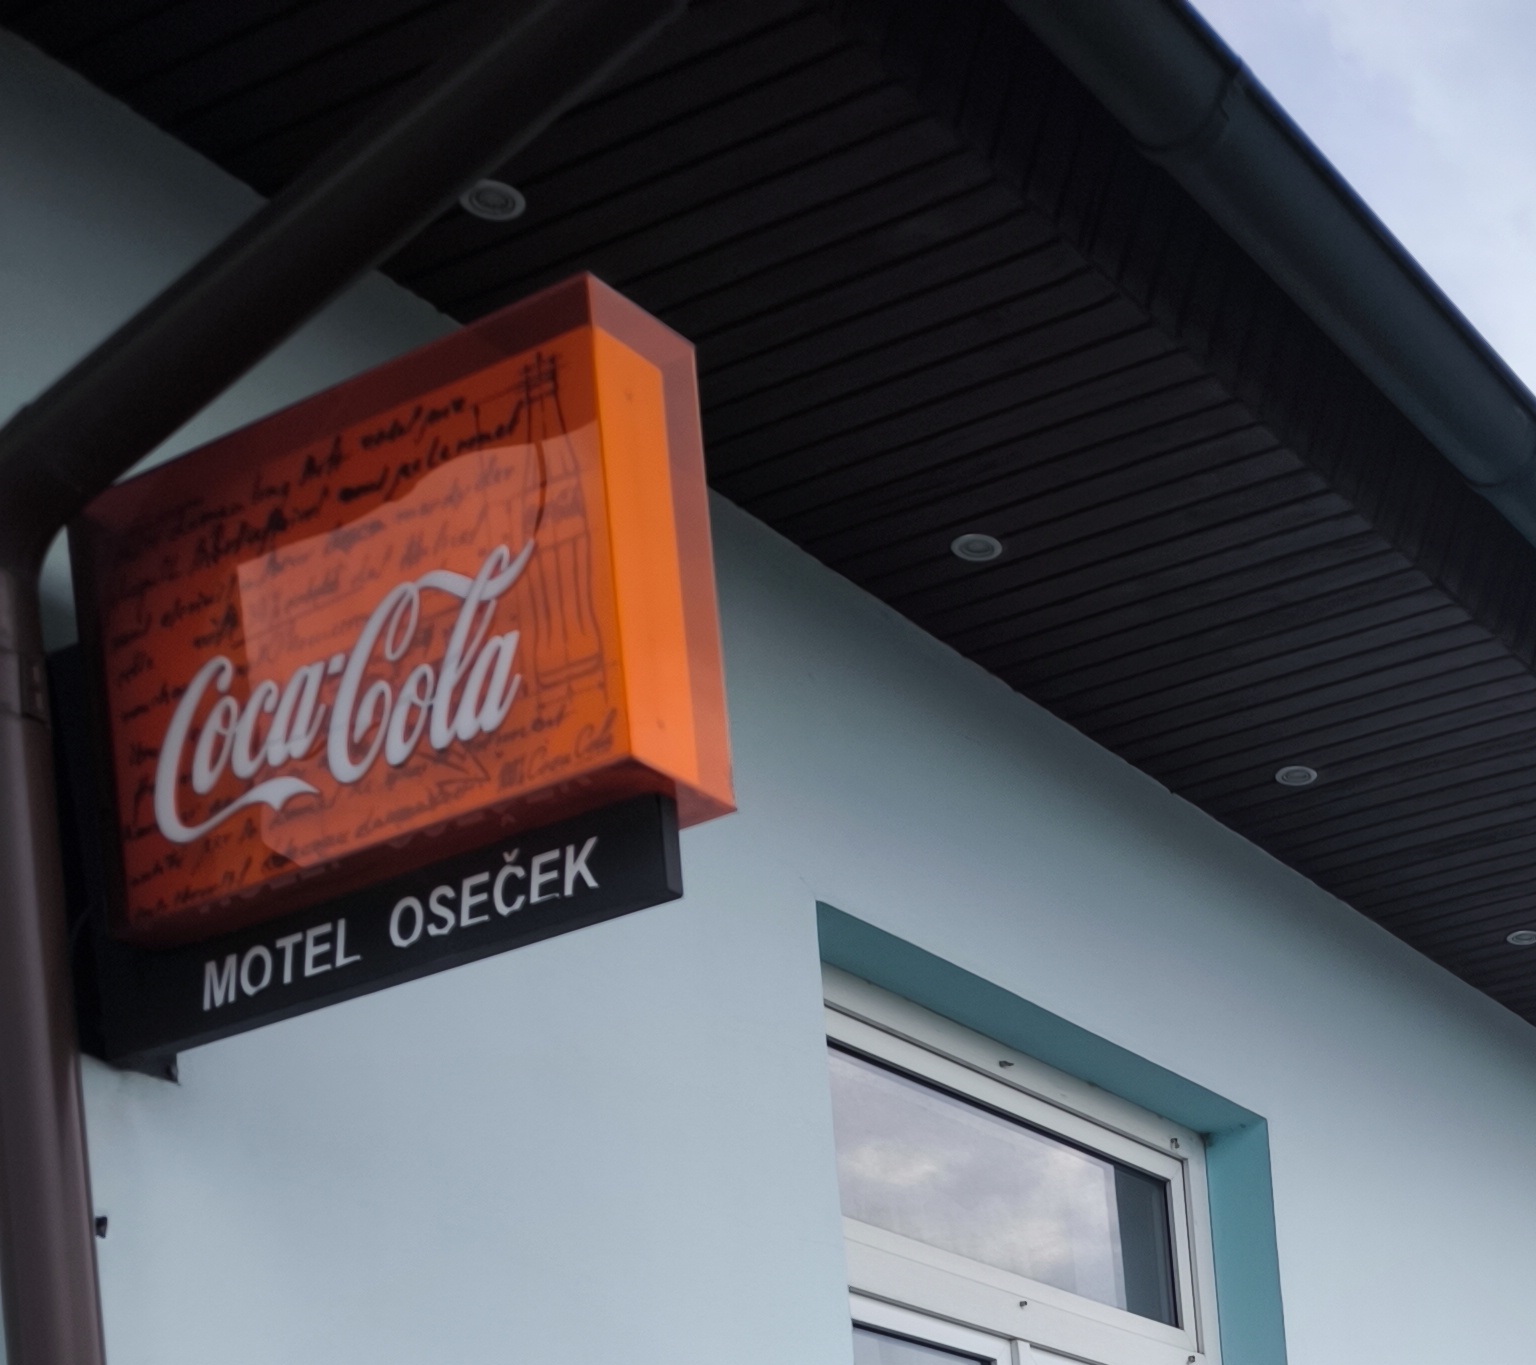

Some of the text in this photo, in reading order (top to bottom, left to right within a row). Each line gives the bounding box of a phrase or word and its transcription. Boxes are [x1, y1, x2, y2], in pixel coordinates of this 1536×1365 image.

[154, 538, 535, 843] Coca-Cola
[202, 835, 599, 1012] MOTEL OSEČEK
